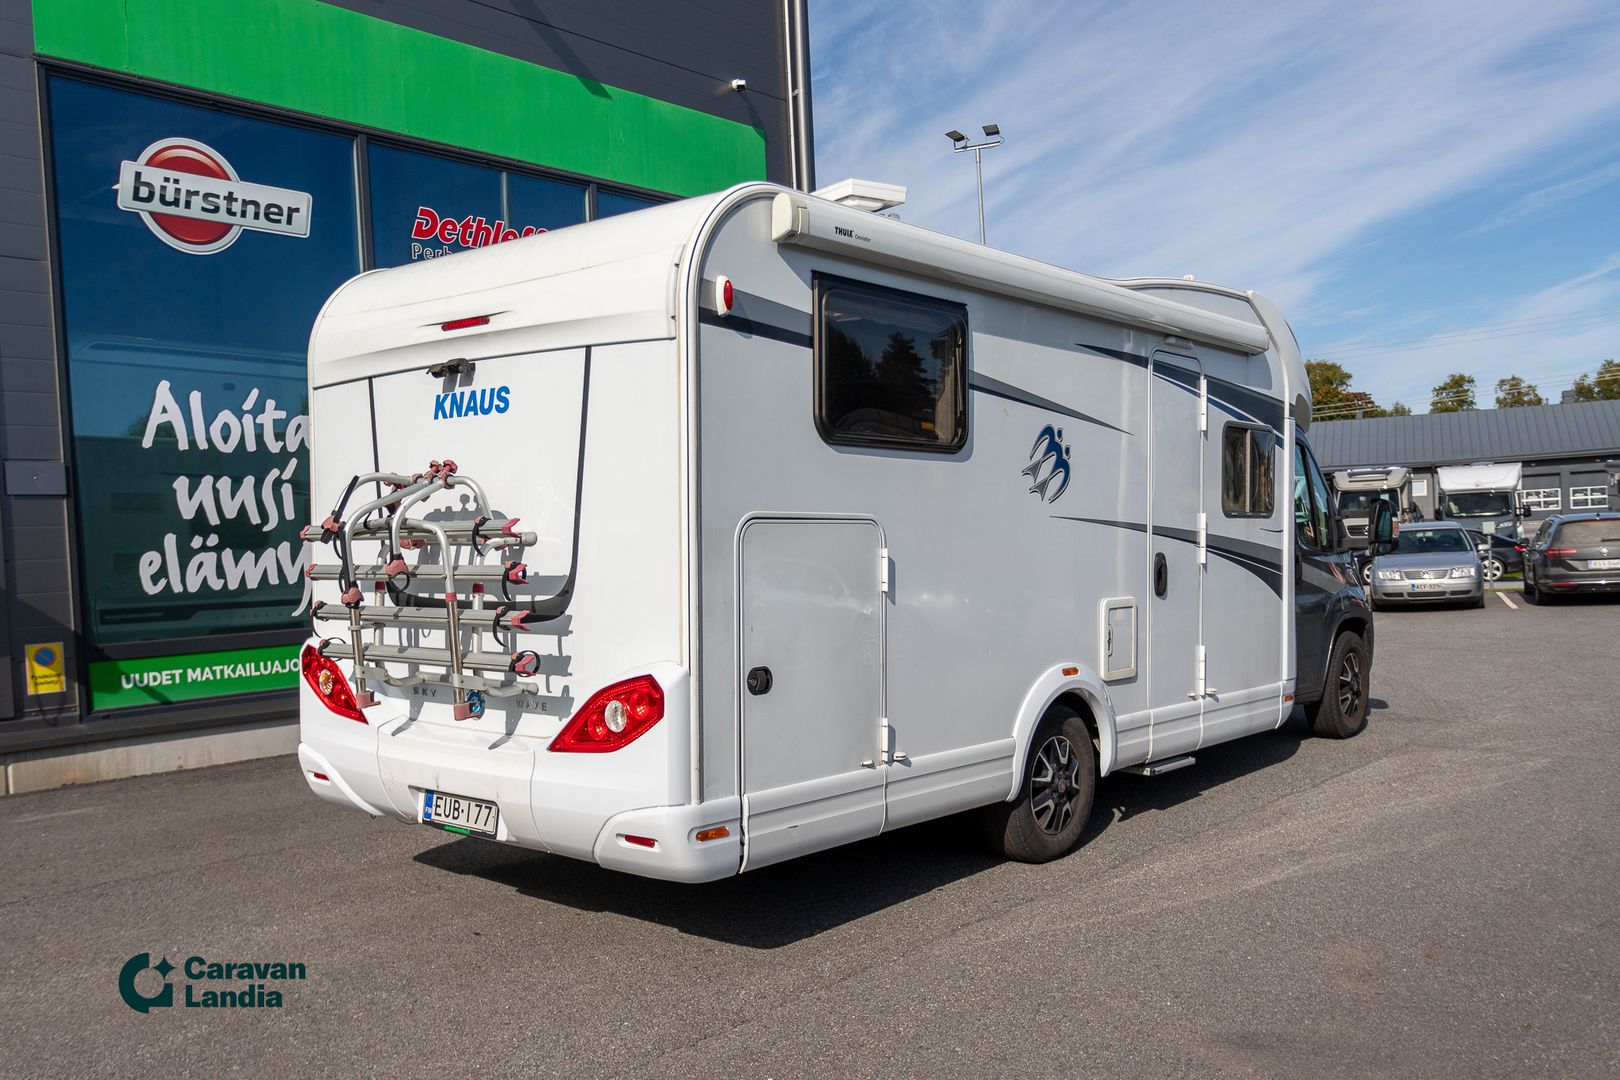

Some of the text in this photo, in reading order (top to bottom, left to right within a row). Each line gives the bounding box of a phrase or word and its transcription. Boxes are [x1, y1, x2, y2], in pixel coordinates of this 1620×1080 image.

[133, 171, 300, 227] bürstner
[834, 226, 854, 238] THULE
[433, 385, 511, 420] KNAUS
[172, 457, 298, 532] uusi
[121, 658, 300, 689] UUDET MATKAILUAJO
[412, 686, 437, 697] SKY
[433, 796, 493, 827] EUB-177
